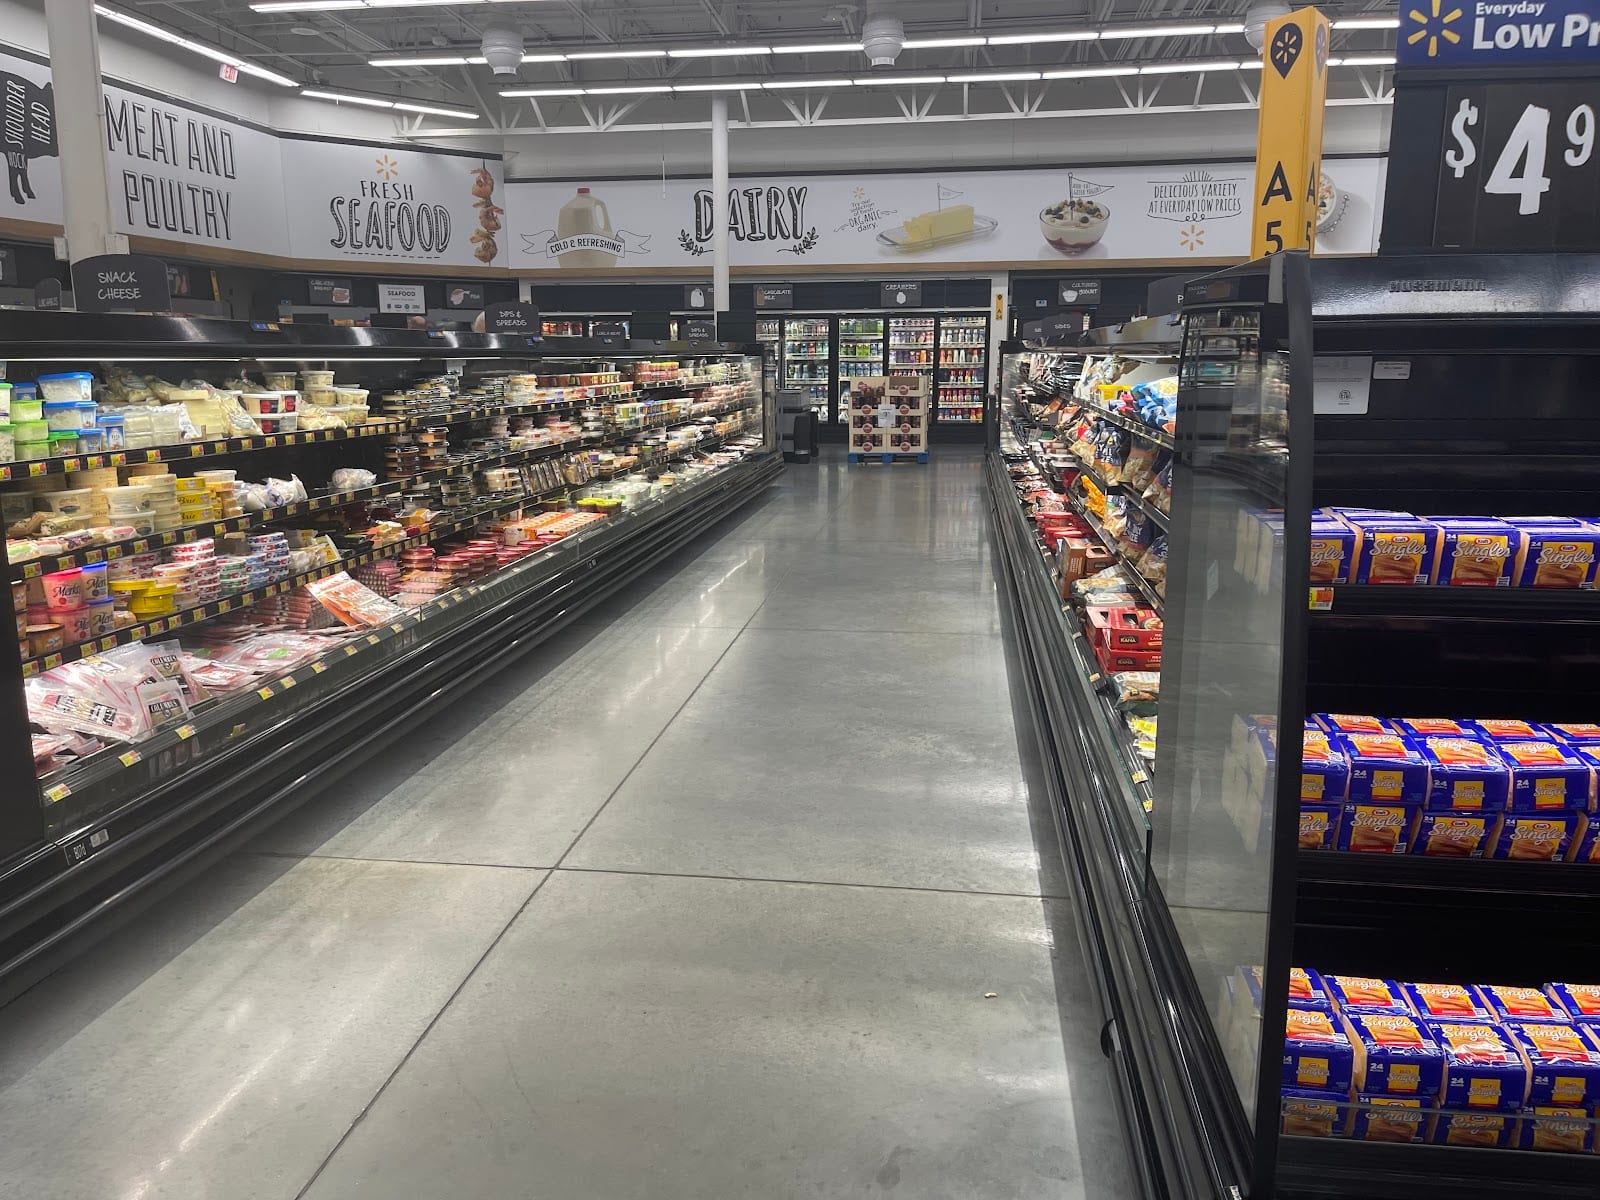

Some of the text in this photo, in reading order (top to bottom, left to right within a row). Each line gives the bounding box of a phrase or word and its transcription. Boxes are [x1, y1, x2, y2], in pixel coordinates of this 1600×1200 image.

[1475, 1, 1545, 16] Everyday
[1473, 16, 1555, 50] Low
[5, 80, 26, 150] SHOULDER
[31, 102, 51, 144] HEAD
[104, 95, 237, 179] MEAT AND
[360, 180, 414, 201] FRESH
[1154, 183, 1236, 198] DELICIOUS VARIETY
[1262, 160, 1293, 206] A
[1306, 161, 1316, 206] A
[122, 169, 232, 240] POULTRY
[693, 186, 808, 242] DAIRY
[1149, 198, 1241, 213] AT EVERYDAY LOW PRICES
[330, 197, 451, 252] SEAFOOD
[849, 210, 882, 227] ORGANIC
[550, 241, 569, 253] COLD
[577, 238, 622, 253] REFRESHING
[1265, 220, 1283, 256] 5
[97, 271, 137, 283] SNACK
[97, 288, 142, 300] CHEESE
[495, 319, 527, 327] SPREADS
[1369, 538, 1429, 560] Singles
[1451, 540, 1512, 562] Singles
[1477, 537, 1490, 545] Kraft
[1311, 545, 1346, 566] ngles
[1535, 547, 1595, 569] Singles
[1353, 769, 1368, 777] 24
[1516, 779, 1529, 787] 24
[1299, 818, 1330, 835] gles
[1350, 811, 1408, 831] Singles
[1428, 822, 1486, 841] Singles
[1510, 825, 1567, 846] Singles
[1287, 1013, 1334, 1025] ngles
[1442, 1027, 1502, 1042] Singles
[1523, 1027, 1583, 1041] Singles
